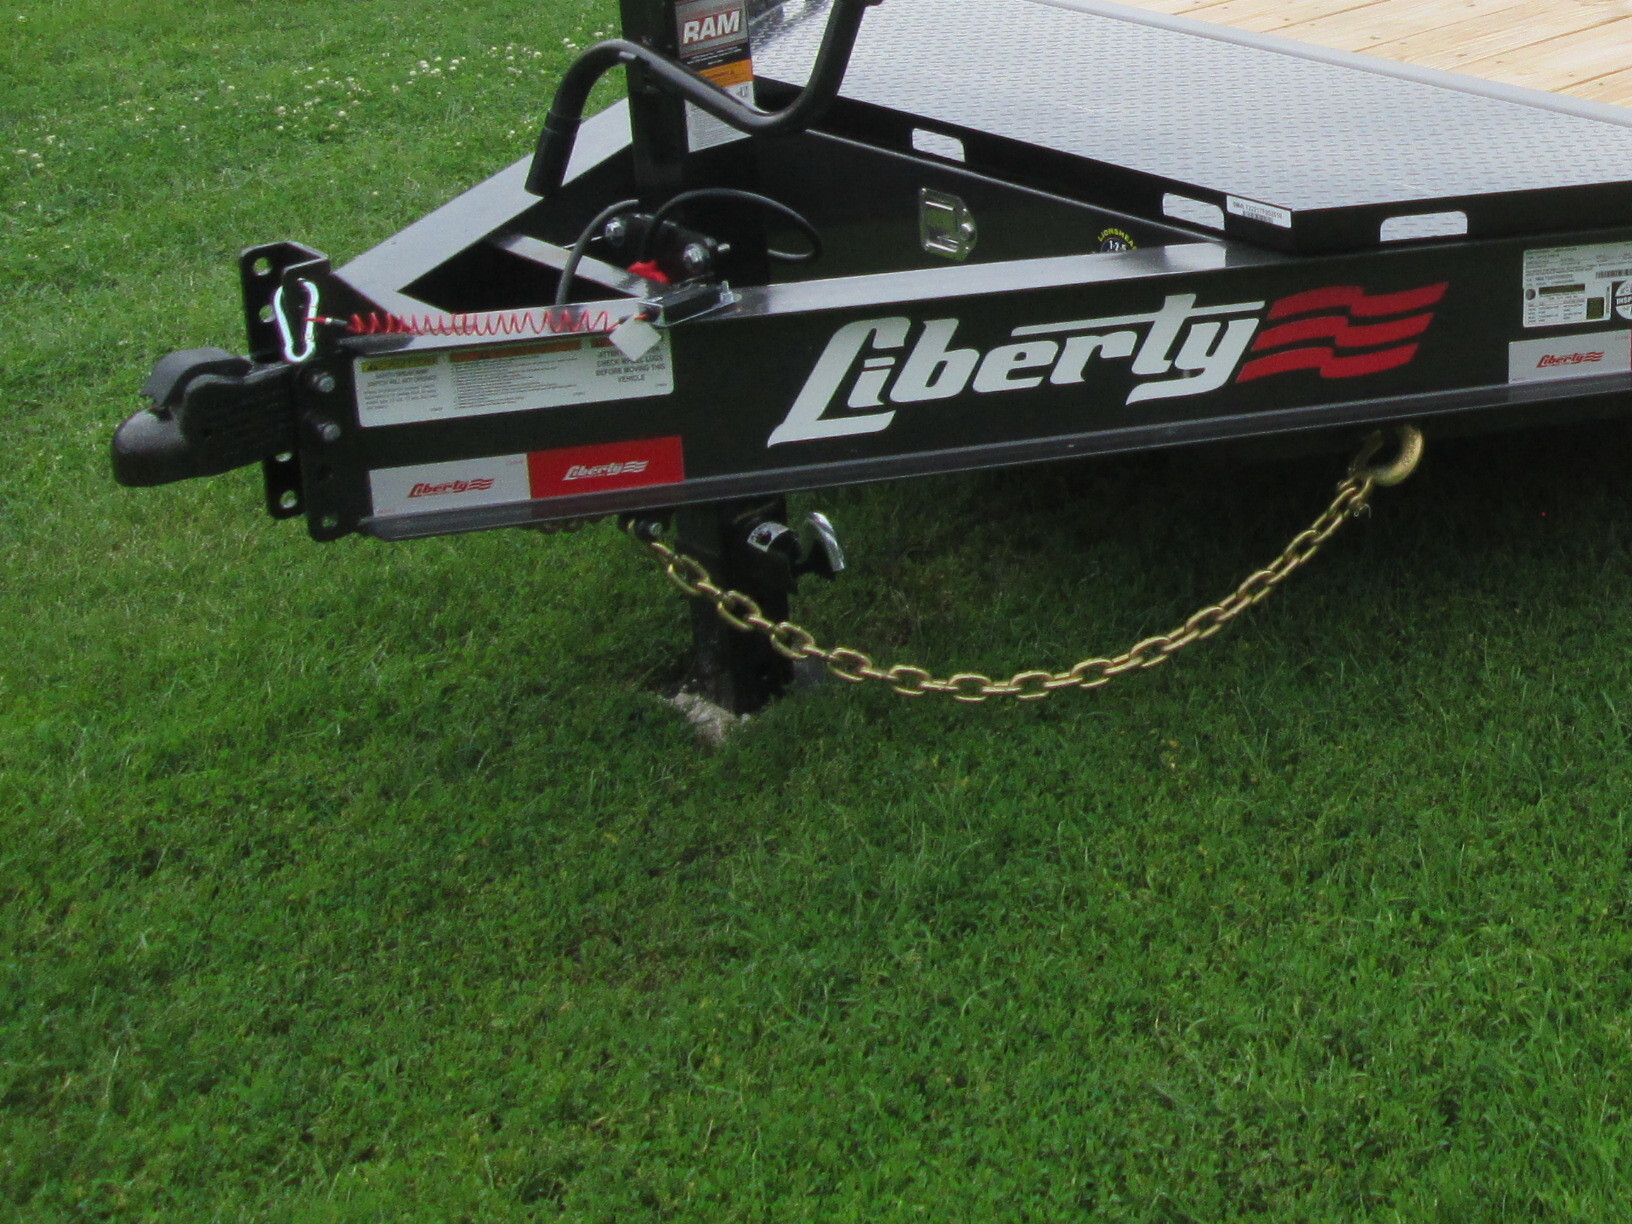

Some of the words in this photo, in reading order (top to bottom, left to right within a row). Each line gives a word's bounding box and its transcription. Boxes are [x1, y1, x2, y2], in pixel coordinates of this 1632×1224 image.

[683, 11, 741, 45] RAM
[1536, 352, 1584, 368] Liberty
[767, 293, 1265, 448] Liberty
[563, 462, 624, 481] Liberty
[407, 479, 469, 498] Liberty
